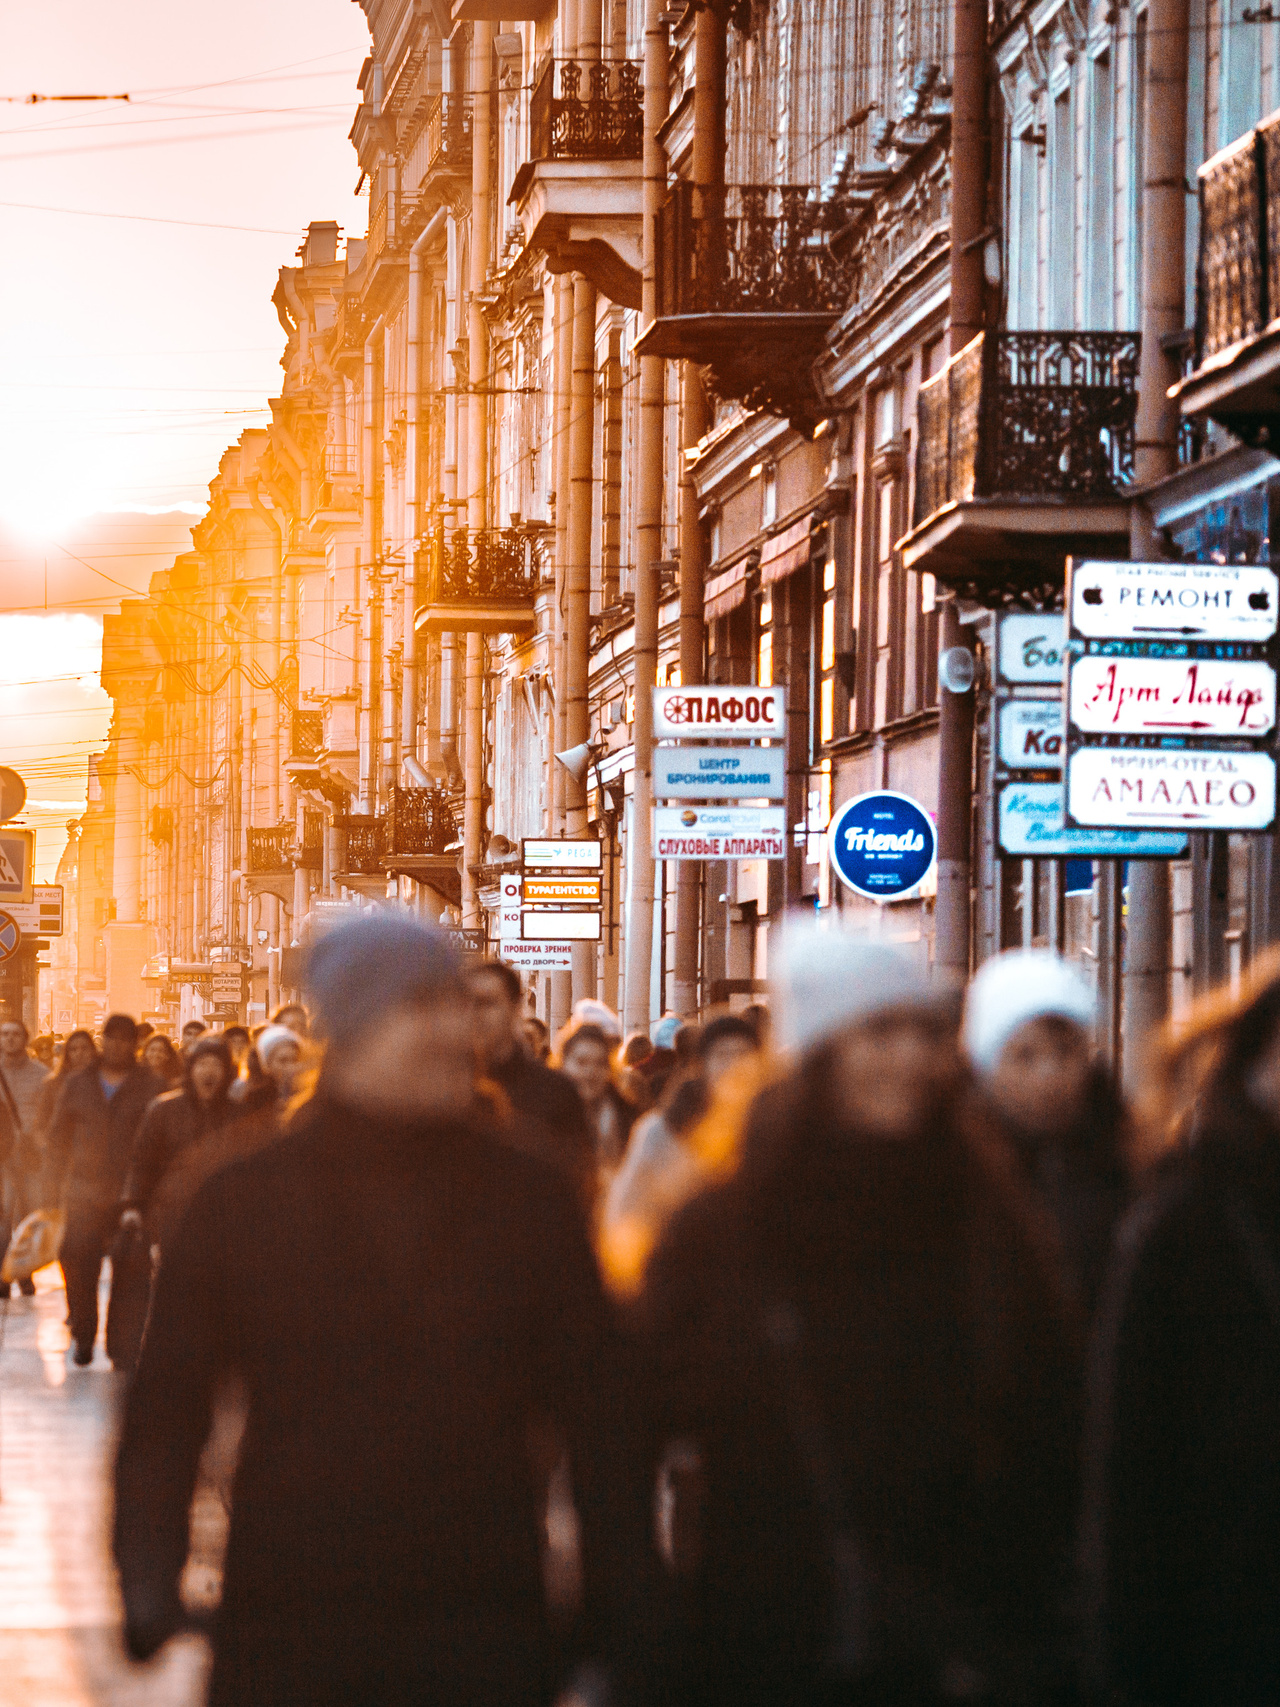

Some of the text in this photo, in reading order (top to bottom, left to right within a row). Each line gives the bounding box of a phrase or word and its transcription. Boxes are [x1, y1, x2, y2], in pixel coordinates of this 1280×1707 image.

[1119, 587, 1233, 609] РЕМОНТ
[1084, 663, 1160, 723] Арт
[684, 696, 775, 724] ПАФОС
[699, 758, 741, 770] ЦЕНТР
[667, 773, 772, 785] БРОНИРОВАНИЯ
[658, 838, 783, 855] СЛУХОВЫЕ АППАРАТЫ
[844, 827, 925, 852] Friends
[527, 885, 598, 896] ТУРАГЕНТСТВО
[503, 945, 572, 953] ПРОВЕРКА ЗРЕНИЯ
